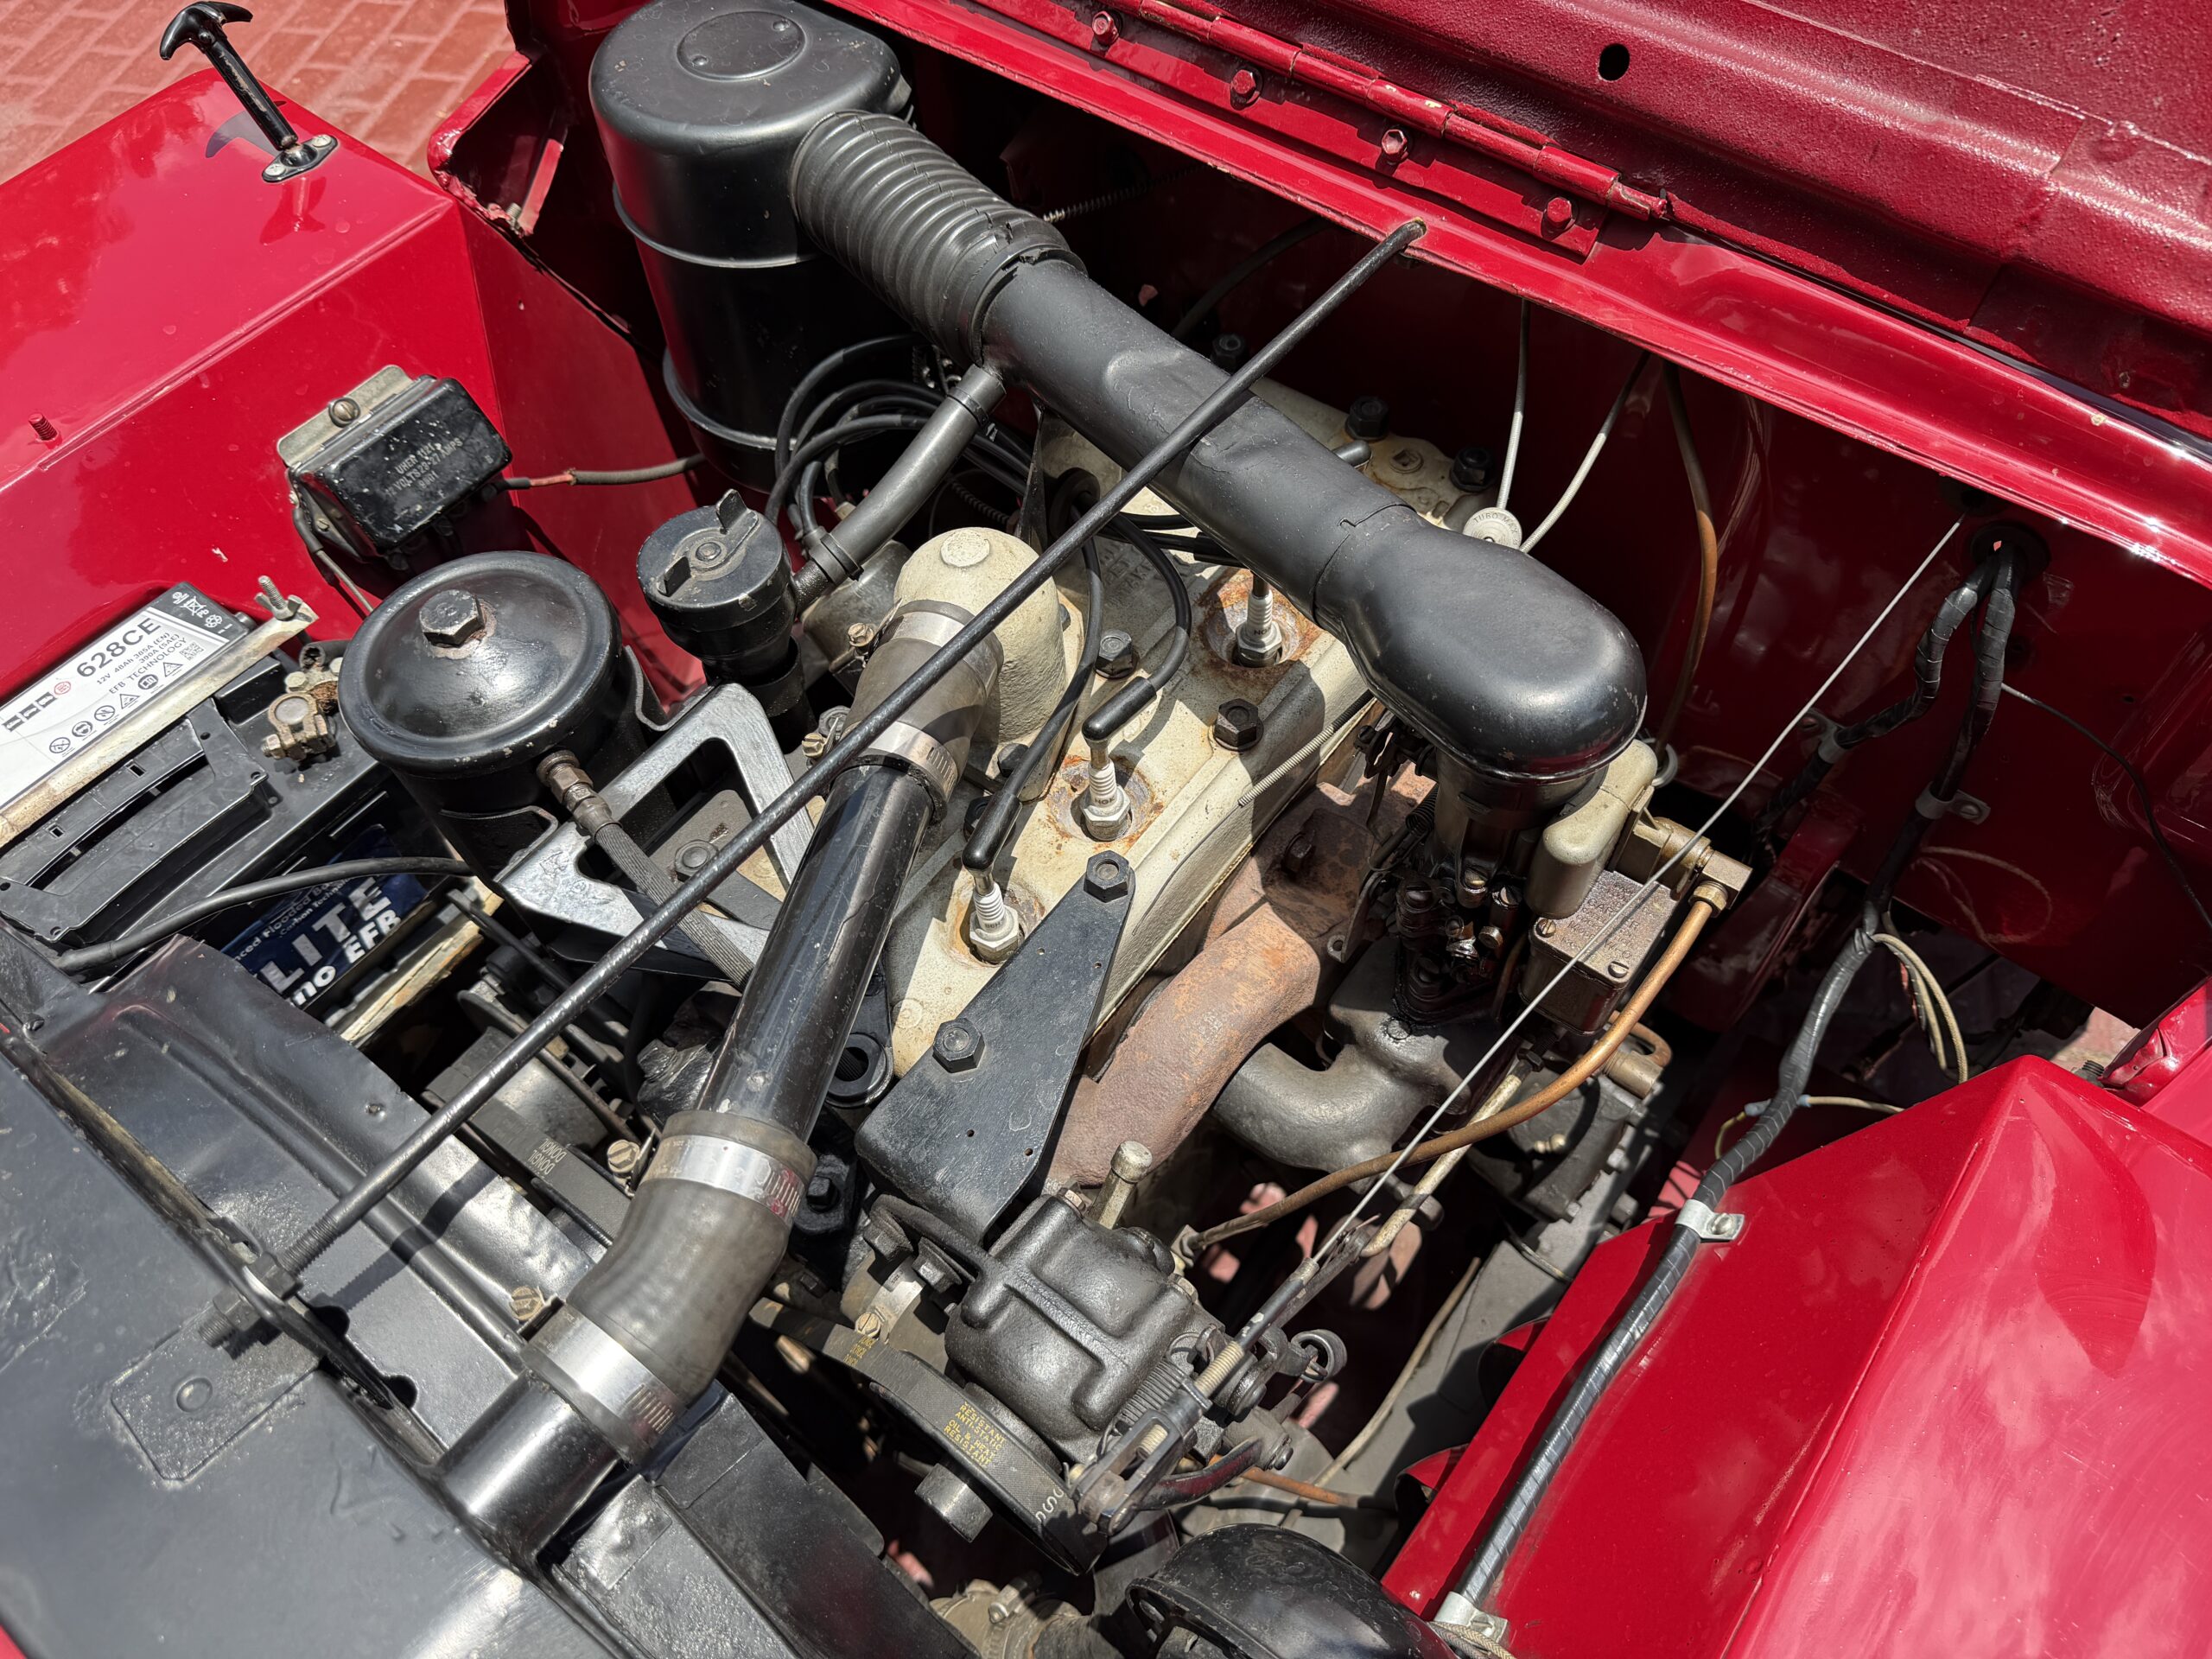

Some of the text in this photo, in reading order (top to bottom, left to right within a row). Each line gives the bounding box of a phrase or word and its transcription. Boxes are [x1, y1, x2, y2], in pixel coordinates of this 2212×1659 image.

[77, 617, 162, 677] 628CE
[97, 673, 111, 685] 12V
[154, 632, 170, 645] (EN)
[159, 633, 180, 650] (SAE)
[109, 638, 187, 694] EFB TECHNOLOGY
[263, 894, 311, 938] Flooded
[342, 909, 401, 963] EFB
[527, 1149, 556, 1175] DONGIL
[538, 1138, 567, 1163] DONGIL
[949, 1420, 961, 1433] OIL
[974, 1440, 995, 1459] HEAT
[960, 1404, 1006, 1444] RESISTANT
[944, 1426, 993, 1465] RESISTANT
